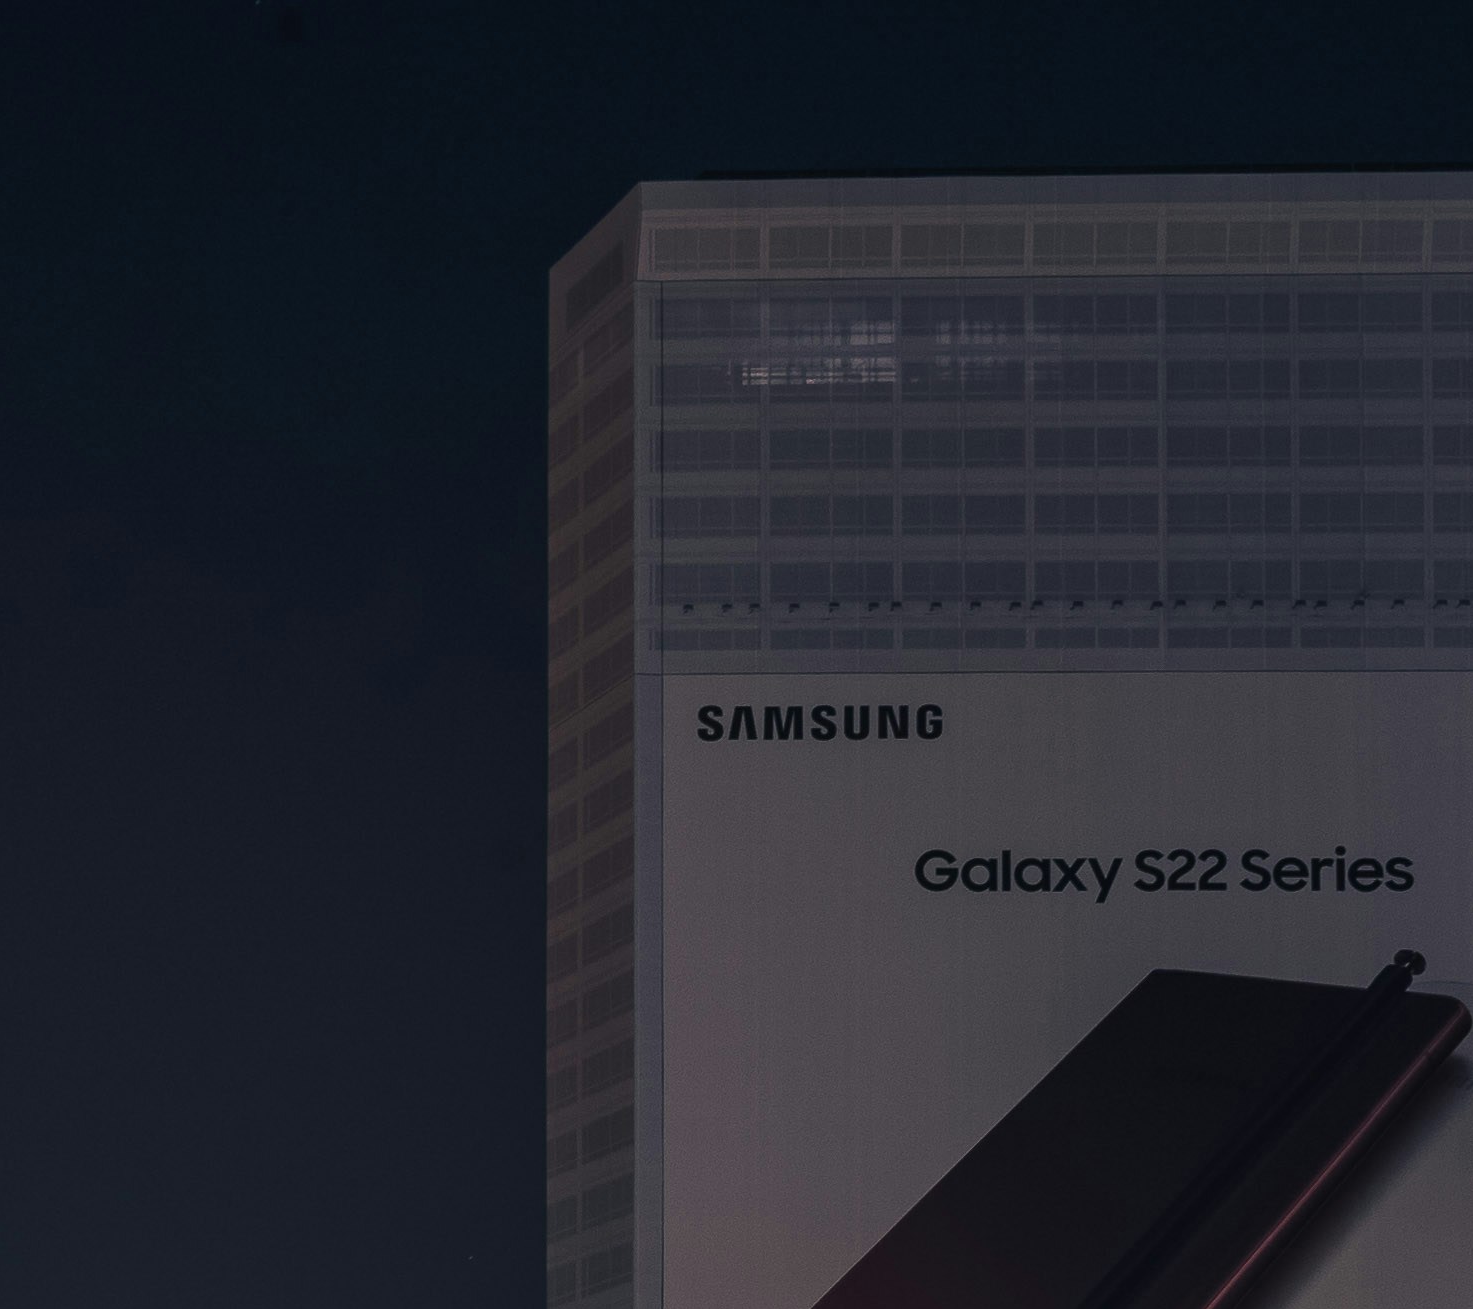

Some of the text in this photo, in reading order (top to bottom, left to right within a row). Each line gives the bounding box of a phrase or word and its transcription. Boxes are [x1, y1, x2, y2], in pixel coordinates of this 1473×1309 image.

[697, 703, 943, 741] SAMSUNG
[914, 845, 1415, 904] Galaxy S22 Series
